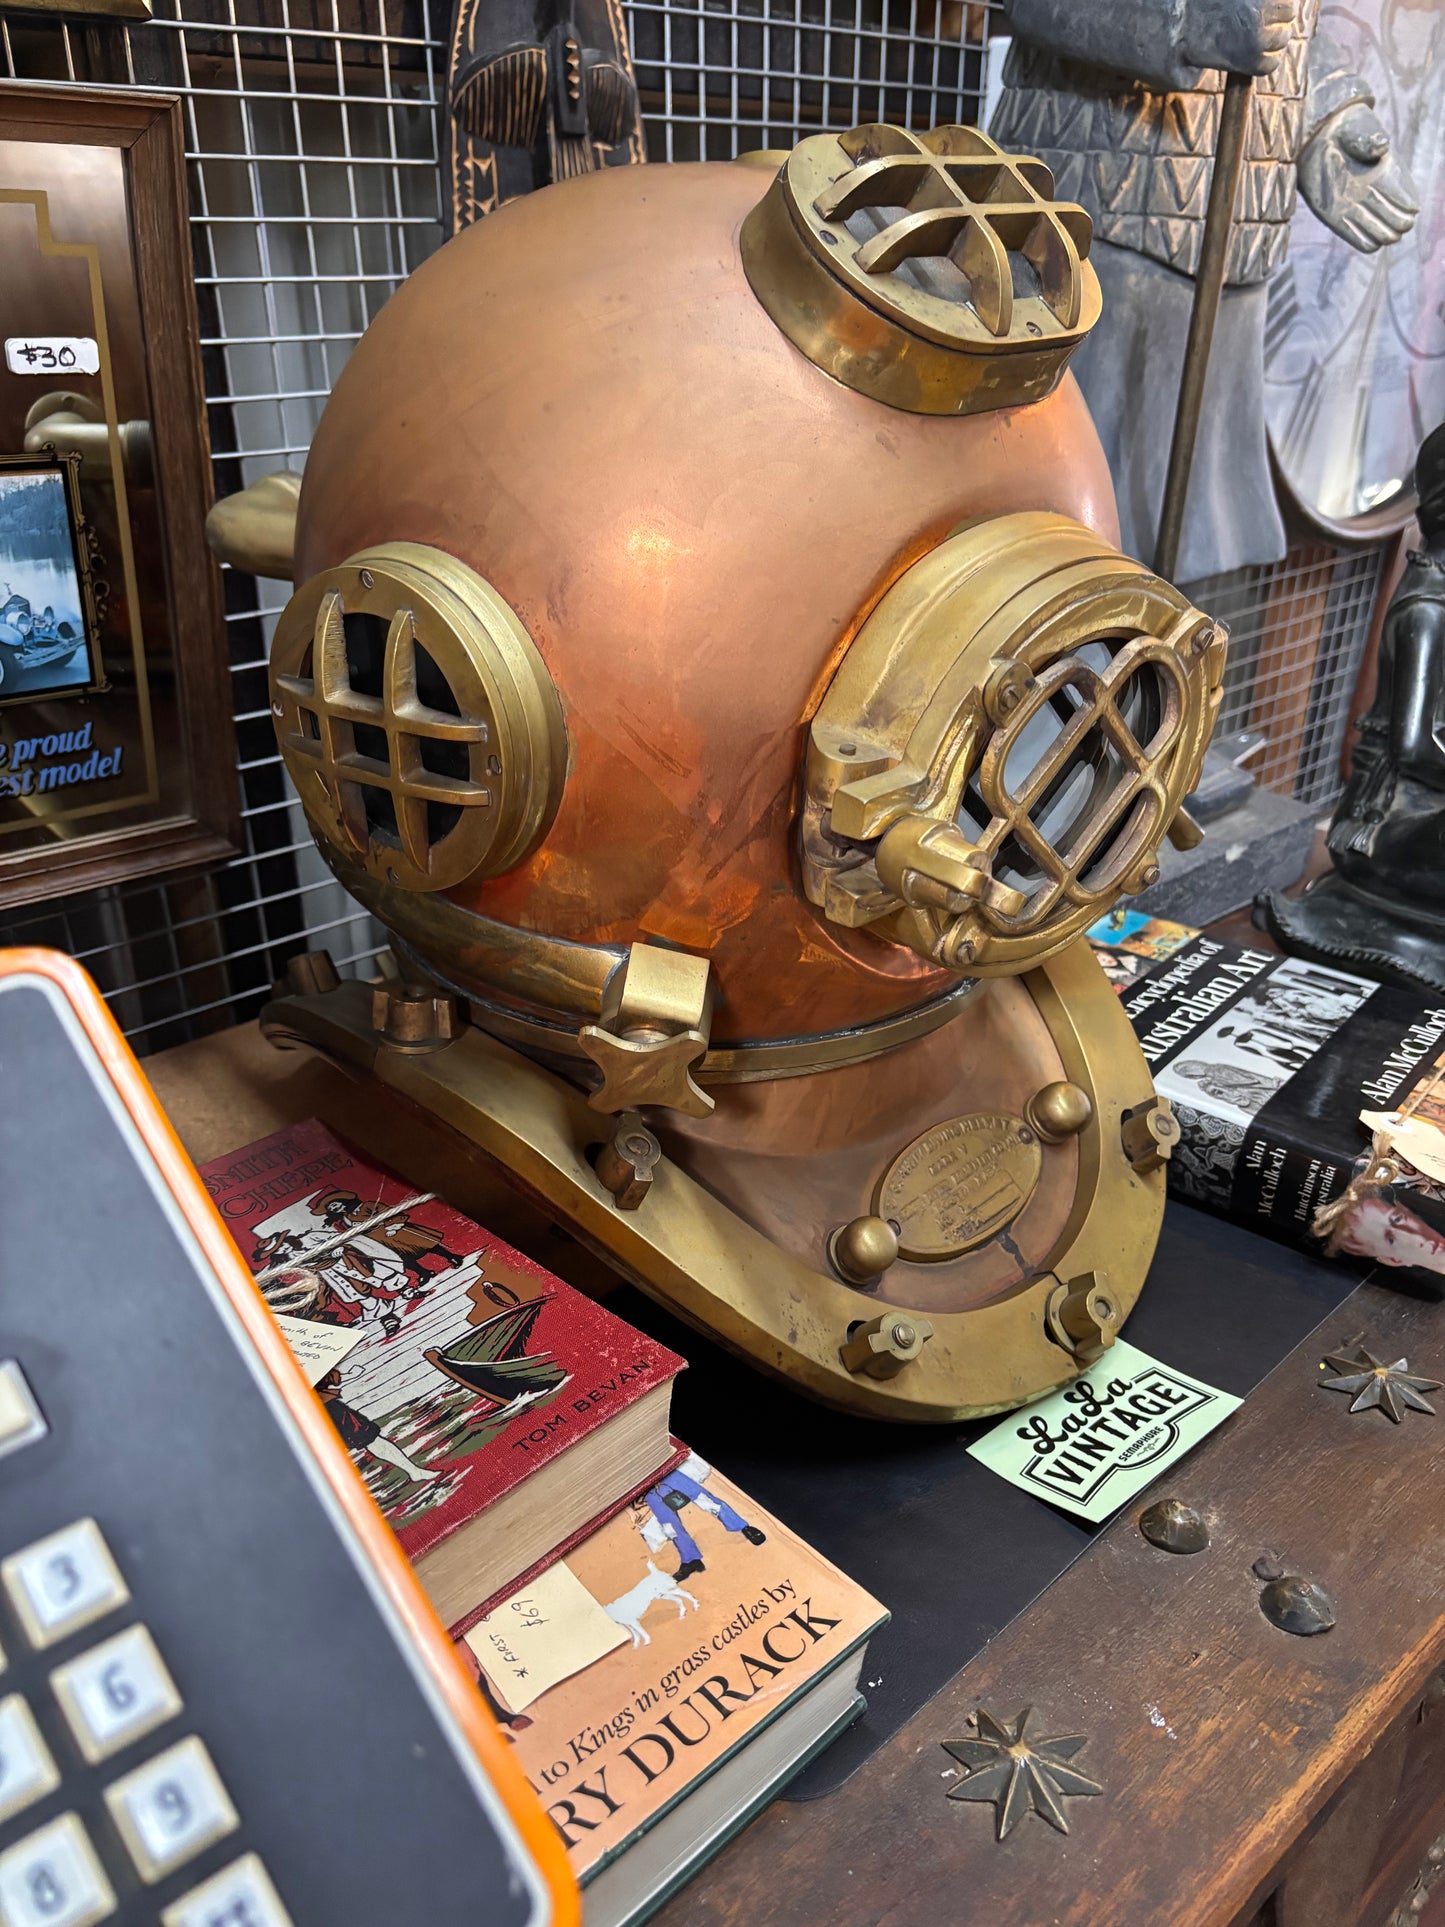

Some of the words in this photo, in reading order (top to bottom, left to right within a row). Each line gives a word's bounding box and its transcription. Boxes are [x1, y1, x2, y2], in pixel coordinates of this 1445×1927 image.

[17, 343, 76, 368] $30
[9, 721, 93, 771] proud
[39, 746, 122, 792] model
[1199, 937, 1224, 956] of
[1140, 976, 1246, 1063] ustralian
[1218, 949, 1275, 983] Art
[1360, 1069, 1407, 1106] Alan
[1246, 1140, 1267, 1175] Alan
[1257, 1147, 1287, 1217] McCulloch
[218, 1151, 354, 1220] CHEPE
[1294, 1159, 1322, 1221] Hutchinson
[1314, 1165, 1337, 1208] ustralia
[512, 1414, 568, 1451] TOM
[571, 1359, 658, 1414] BEVAN.
[1044, 1381, 1190, 1486] VINTAGE
[1118, 1425, 1165, 1462] SEMAPHORE
[47, 1553, 82, 1600] 3
[510, 1599, 551, 1628] $69
[100, 1659, 137, 1711] 6
[540, 1760, 570, 1785] to
[566, 1704, 636, 1765] Kings
[631, 1688, 660, 1713] in
[659, 1645, 712, 1698] grass
[711, 1599, 770, 1651] castles
[761, 1578, 797, 1605] by
[545, 1764, 626, 1850] RY
[616, 1596, 843, 1786] DURACK
[154, 1777, 192, 1834] 9
